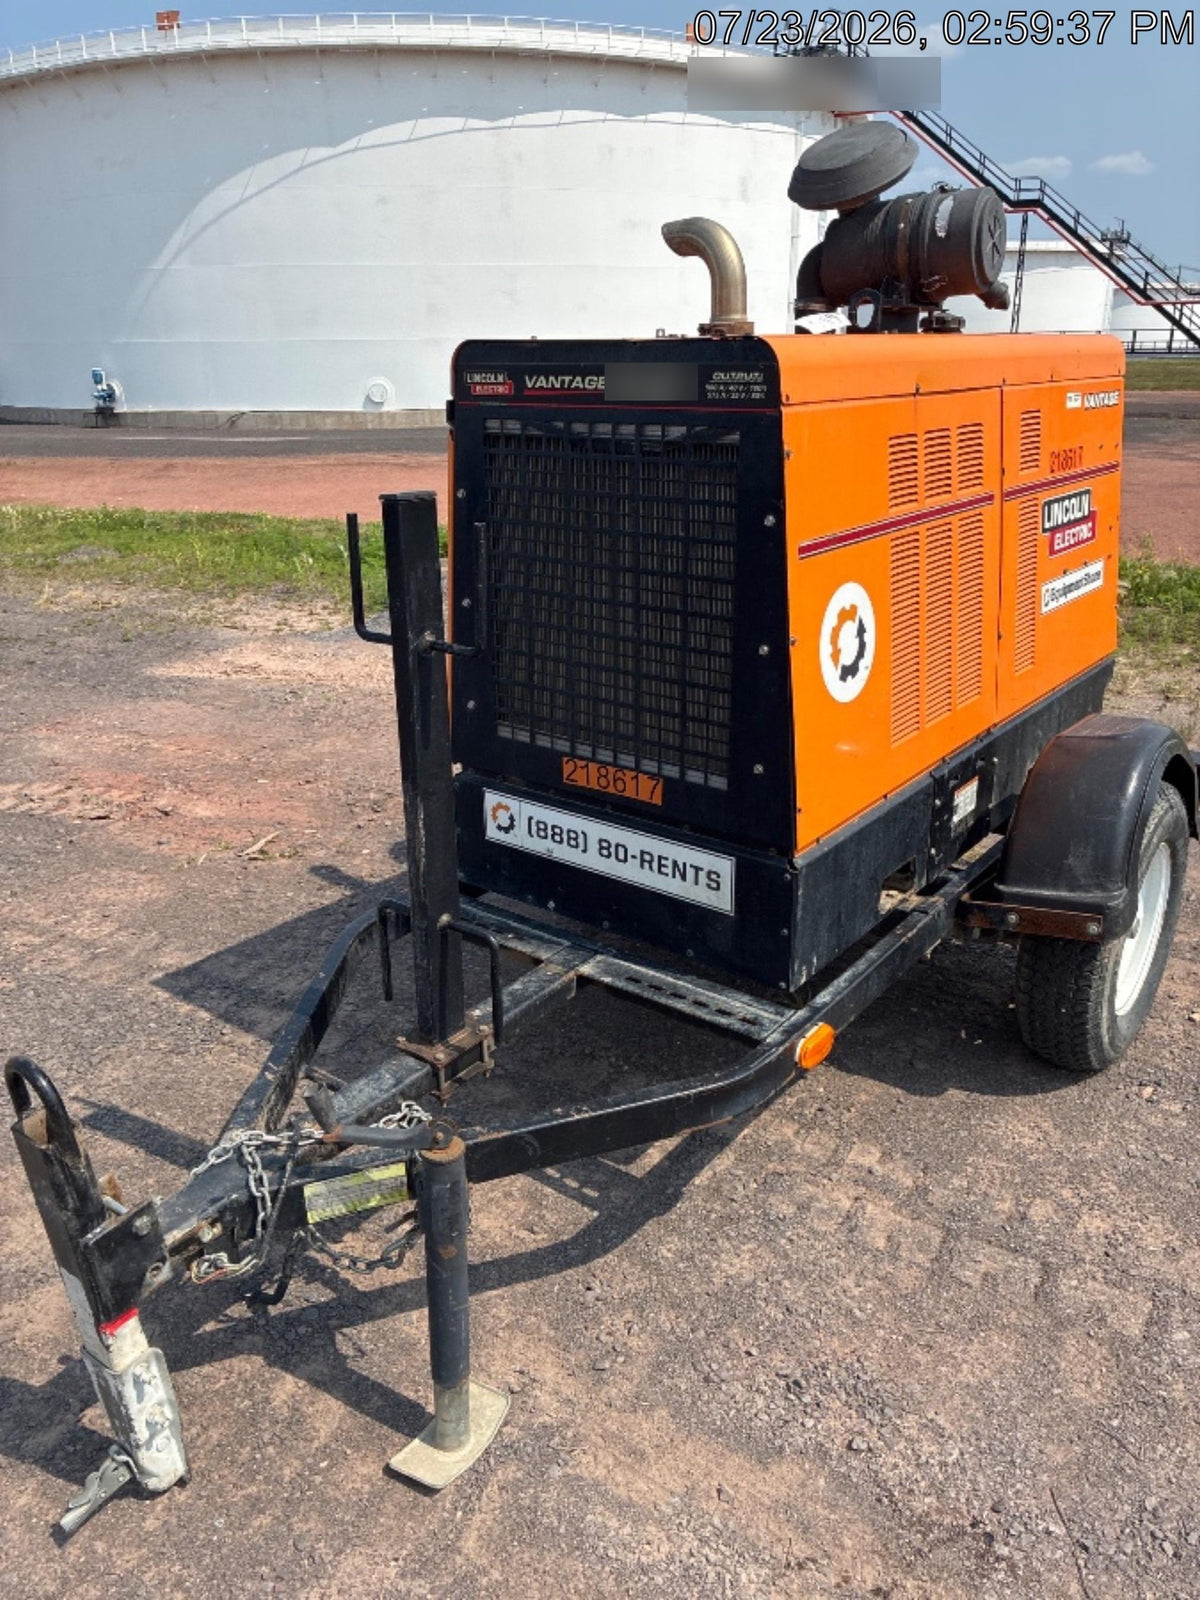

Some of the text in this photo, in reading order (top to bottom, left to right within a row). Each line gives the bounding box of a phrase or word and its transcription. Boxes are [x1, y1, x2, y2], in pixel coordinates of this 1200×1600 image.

[467, 372, 505, 383] LINCOLN
[525, 374, 606, 390] VANTAGE
[1043, 493, 1090, 530] LINCOLN
[1053, 521, 1094, 552] ELECTRIC
[564, 758, 661, 801] 218617
[526, 815, 722, 892] (888) 80-RENTS
